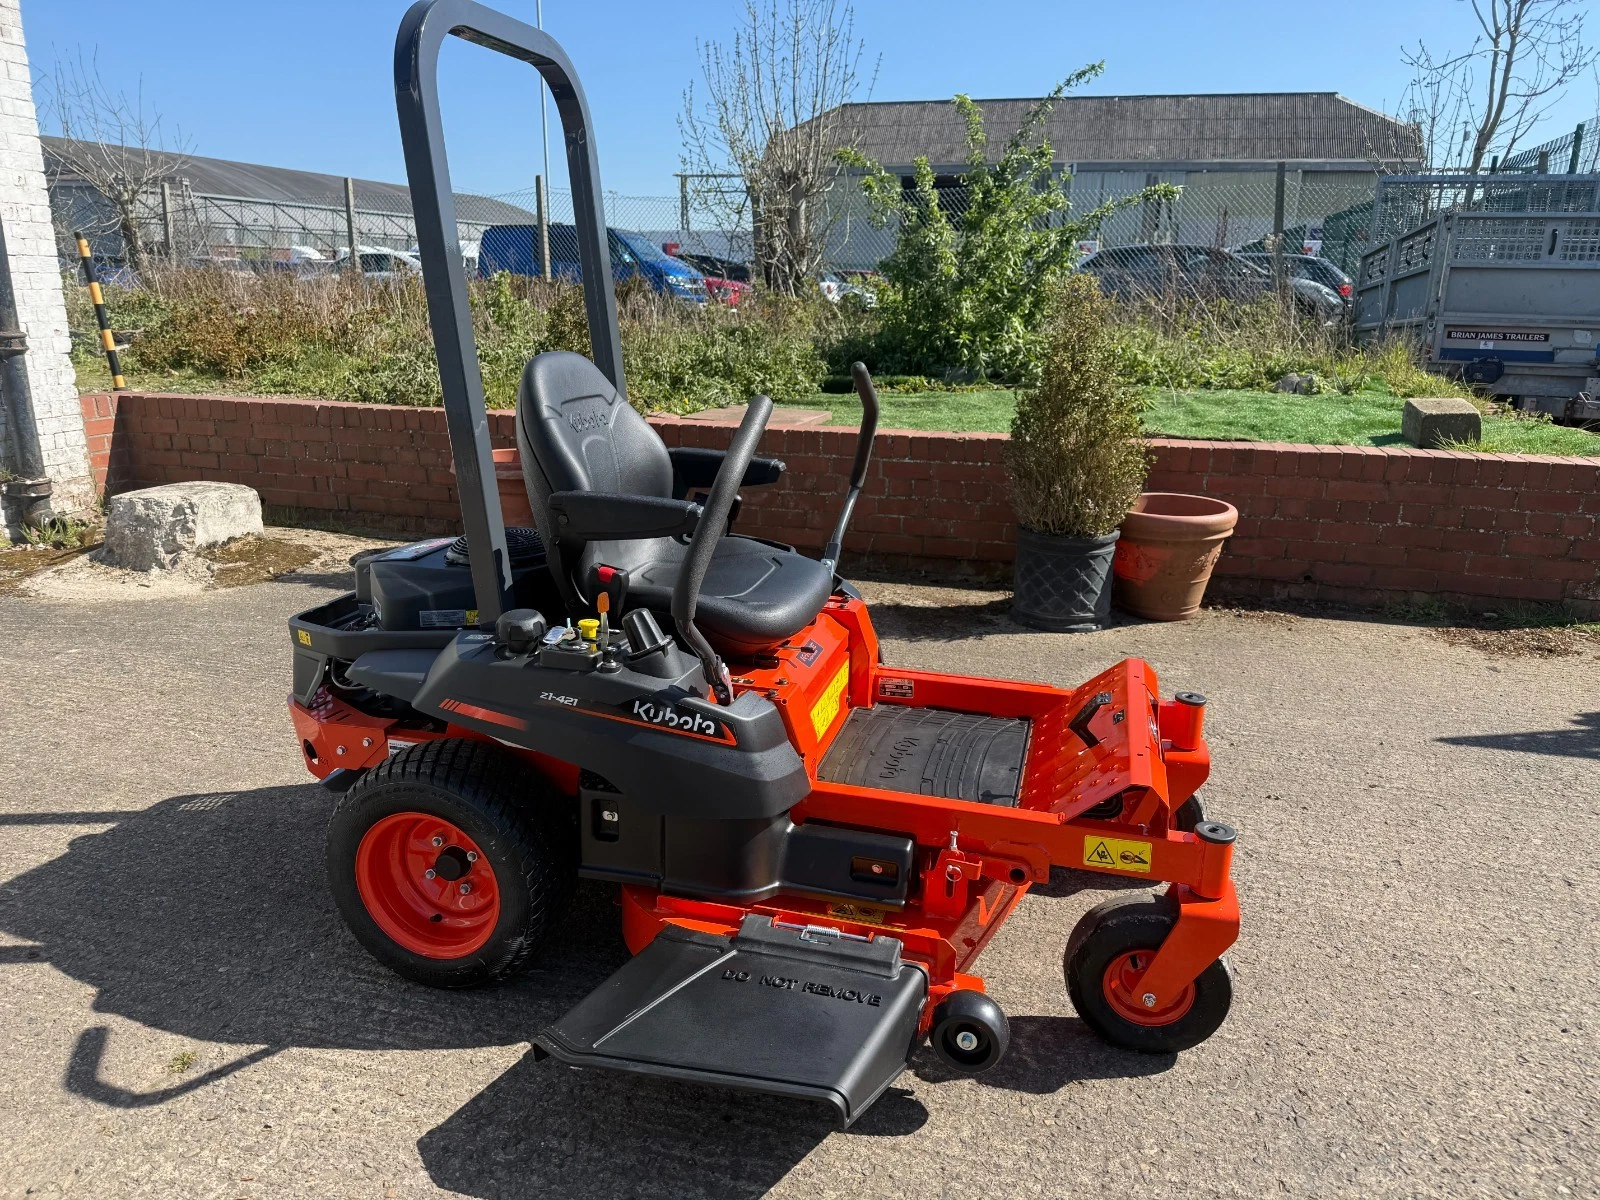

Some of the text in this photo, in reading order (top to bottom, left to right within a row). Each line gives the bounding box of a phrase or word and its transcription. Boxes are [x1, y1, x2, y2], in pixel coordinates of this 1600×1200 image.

[1451, 331, 1545, 341] BRIAN JAMES TRAILERS
[633, 700, 716, 735] Kubota
[879, 737, 920, 778] Kubota
[721, 969, 882, 1007] DO NOT REMOVE
